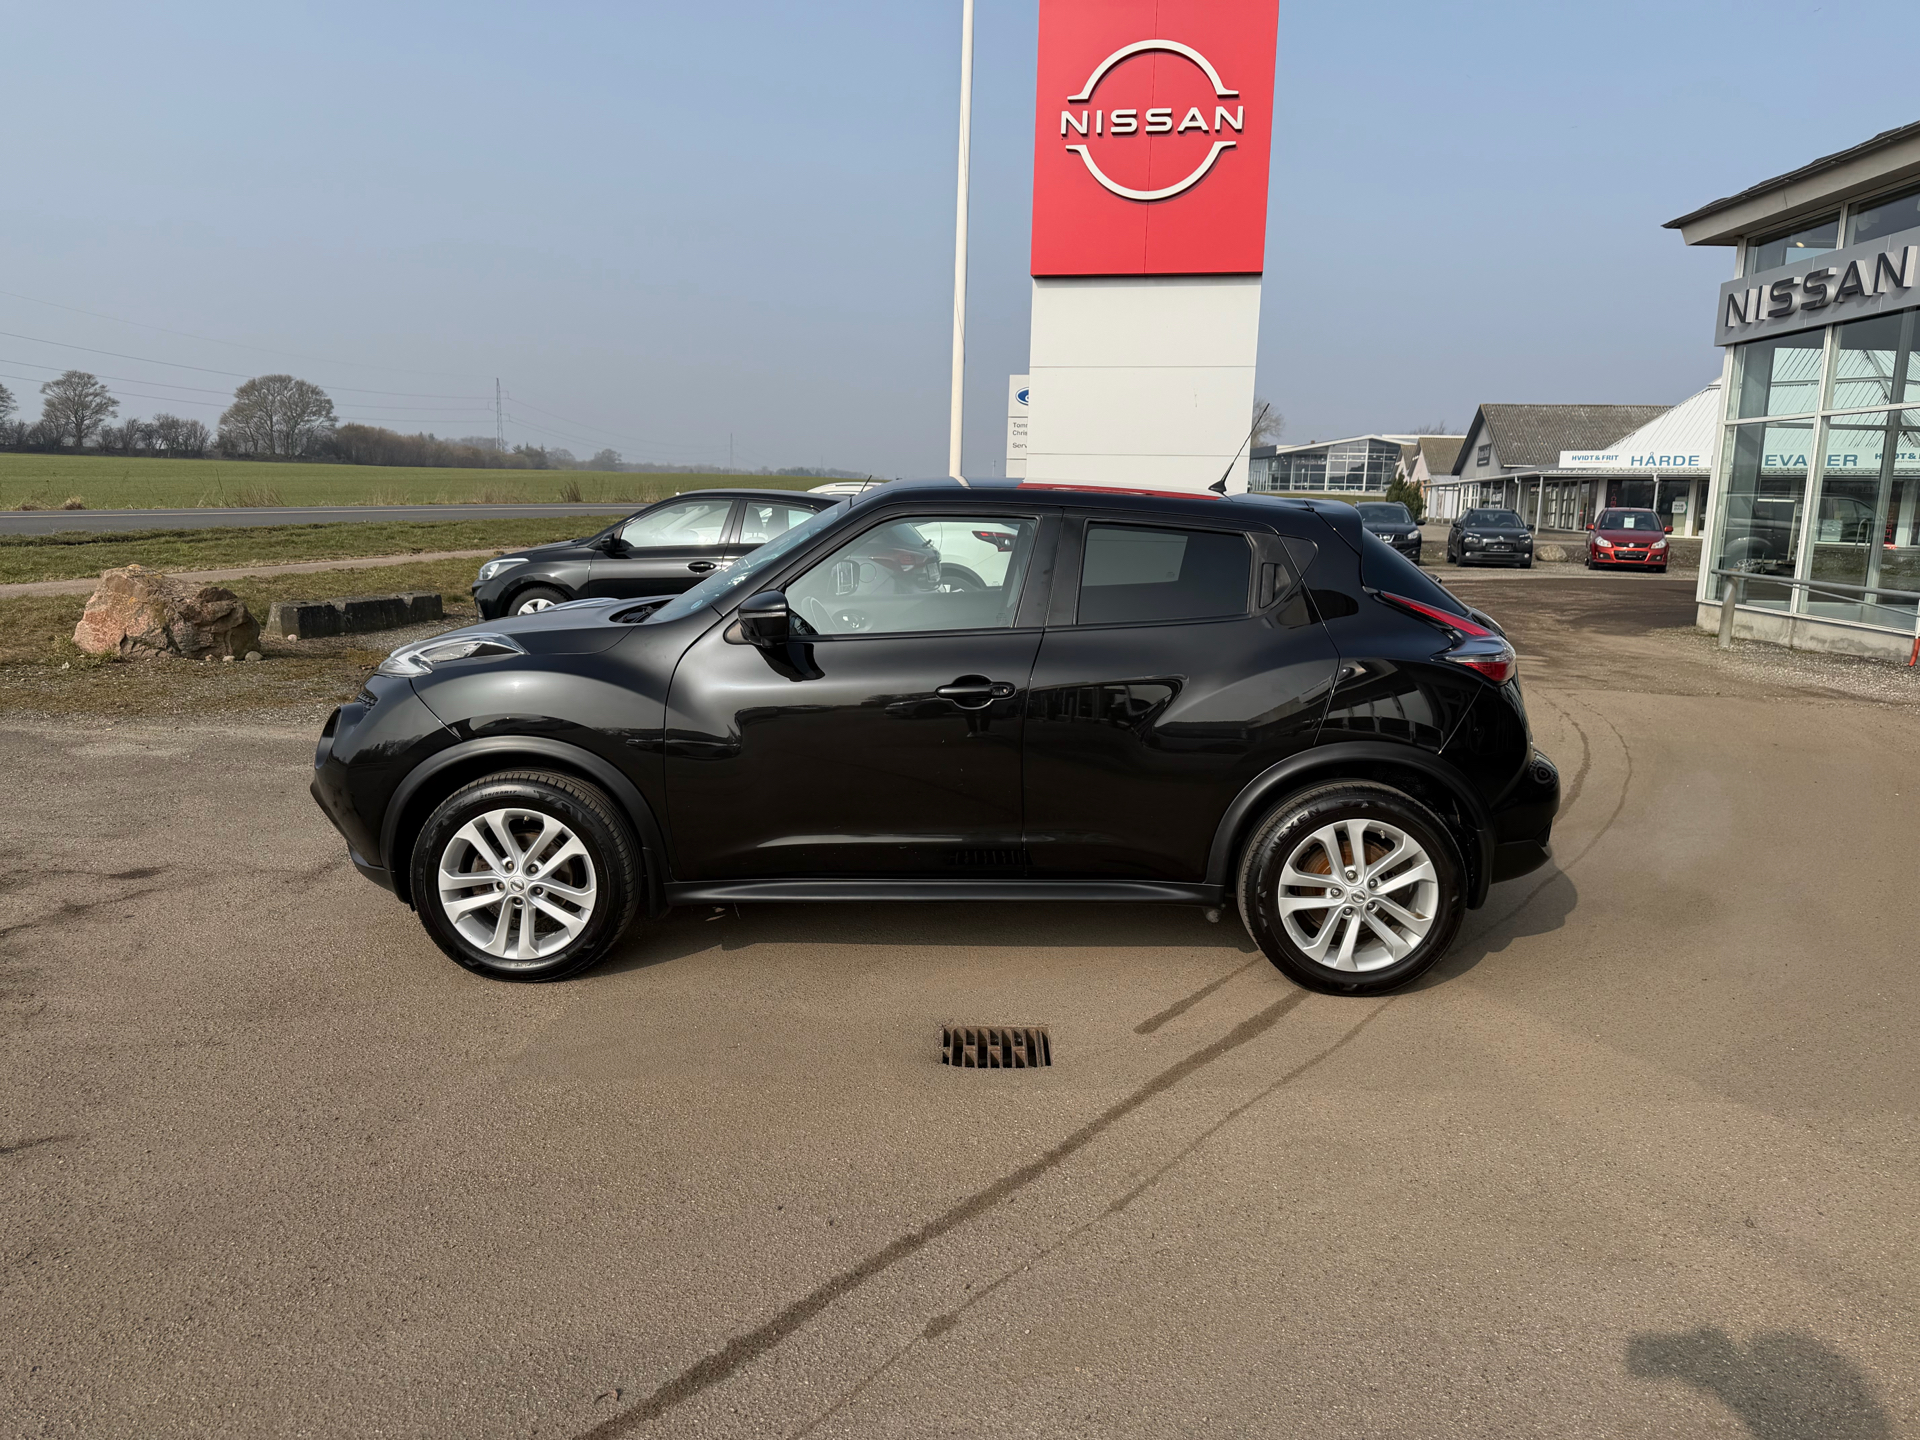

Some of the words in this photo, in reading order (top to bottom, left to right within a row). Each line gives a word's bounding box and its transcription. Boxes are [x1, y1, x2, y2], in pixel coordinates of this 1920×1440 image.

[1060, 105, 1244, 135] NISSAN
[1724, 245, 1918, 328] NISSAN
[1630, 451, 1699, 466] HÅRDE
[1268, 806, 1321, 853] NEXEN
